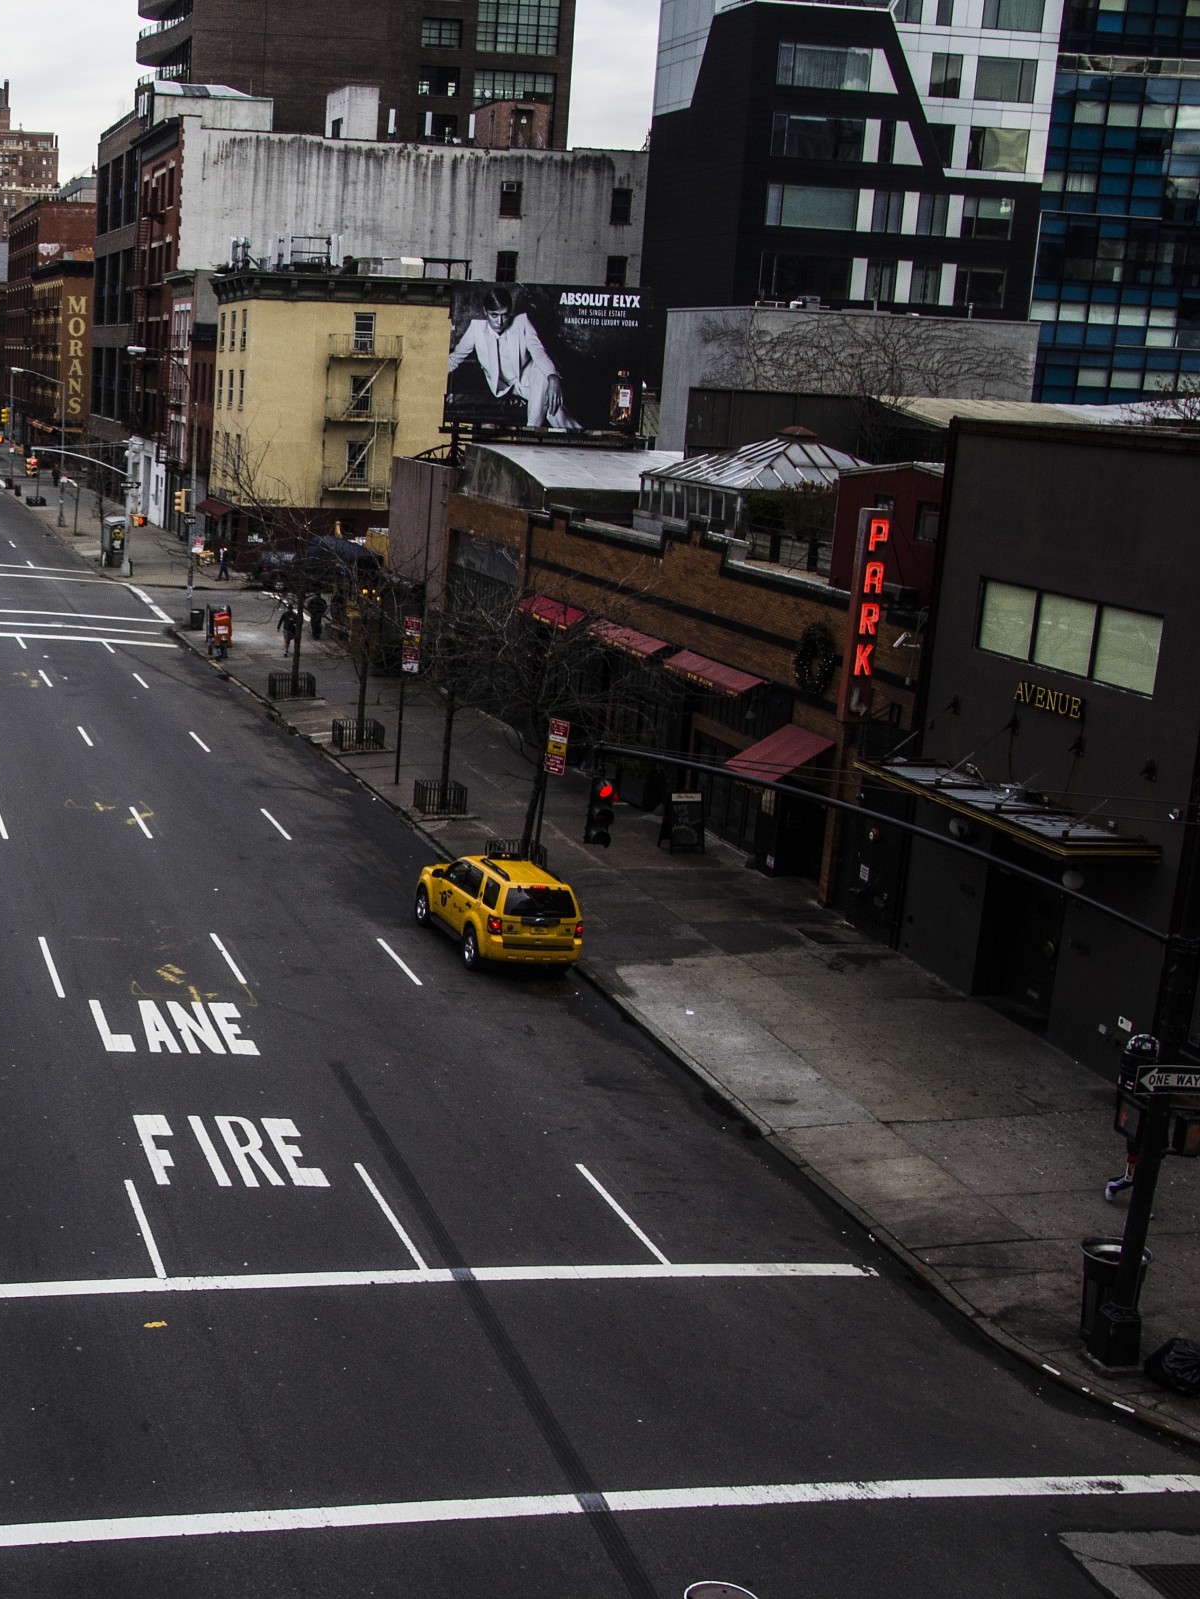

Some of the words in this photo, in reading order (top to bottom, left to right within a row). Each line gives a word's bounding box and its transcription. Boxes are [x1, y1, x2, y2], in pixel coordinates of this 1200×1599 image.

[559, 292, 610, 307] ABSOLUT
[613, 294, 641, 308] ELYX
[589, 309, 607, 317] SINGLE
[608, 310, 626, 318] ESTATE
[564, 317, 600, 326] HANDCRAFTED
[601, 318, 620, 327] LUXURY
[622, 319, 639, 327] VODKA
[853, 518, 890, 676] PARK
[1013, 681, 1082, 719] AVENUE
[88, 999, 261, 1056] LANE
[1148, 1074, 1171, 1086] ONE
[1176, 1075, 1200, 1087] WAY
[132, 1114, 331, 1188] FIRE
